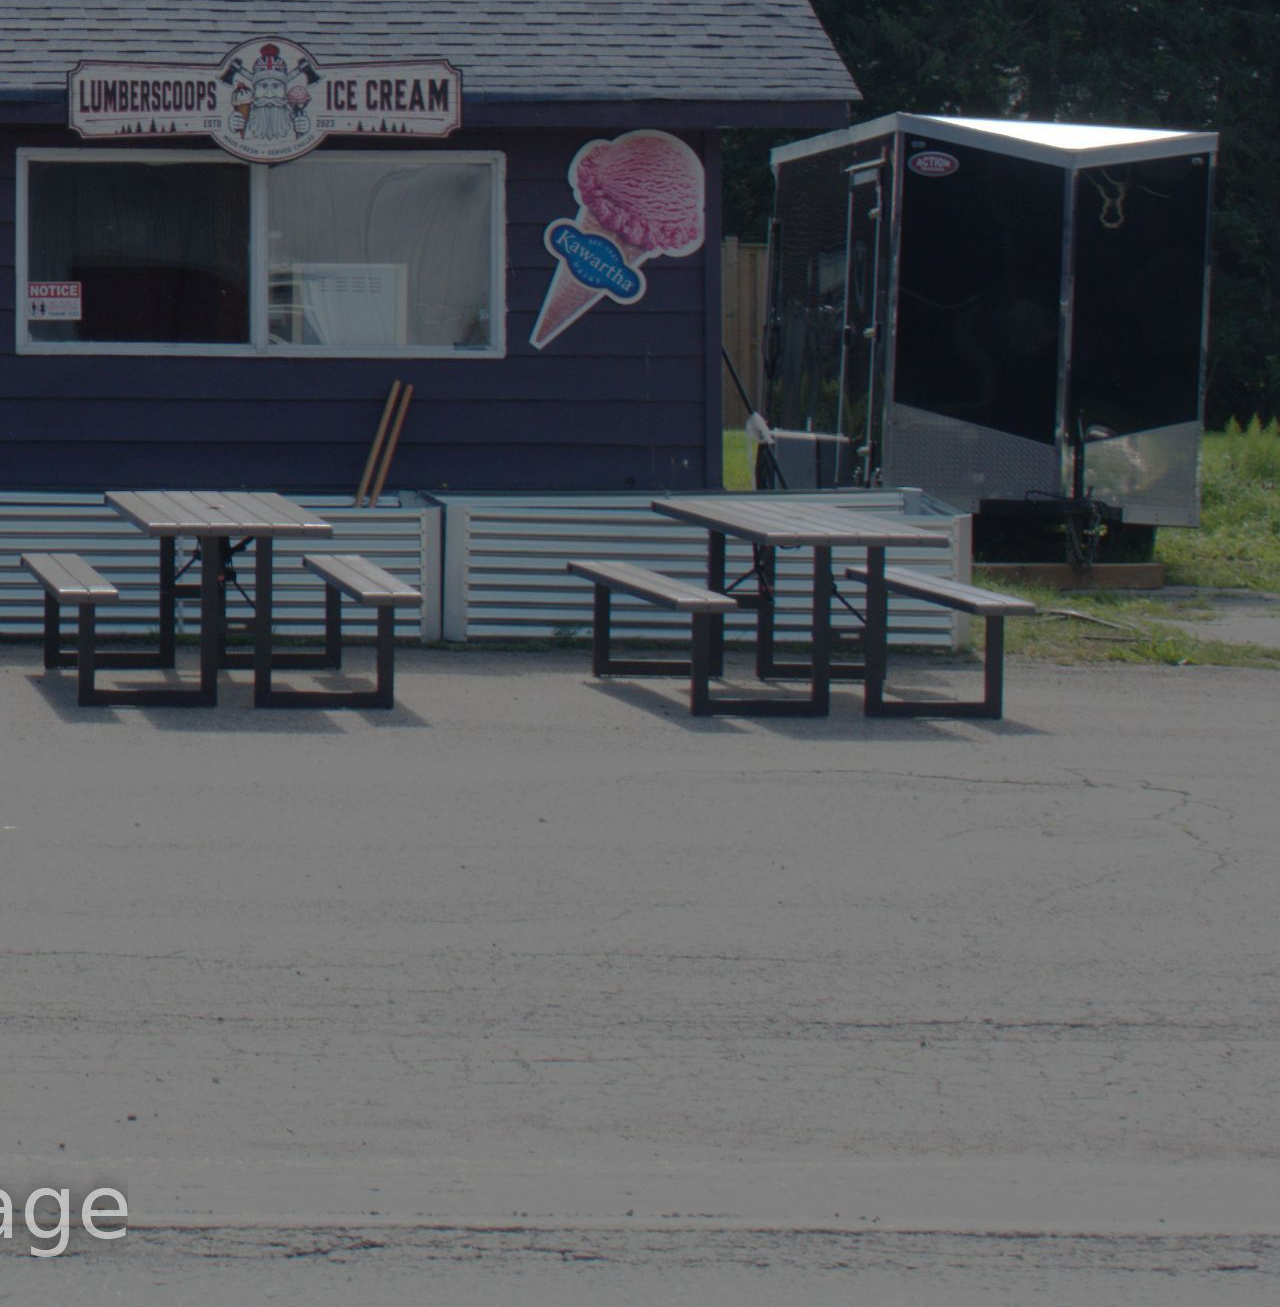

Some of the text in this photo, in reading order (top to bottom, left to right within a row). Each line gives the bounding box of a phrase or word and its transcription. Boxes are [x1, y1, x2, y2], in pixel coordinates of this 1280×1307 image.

[79, 79, 217, 113] LUMBERSCOOPS
[326, 79, 450, 112] ICE CREAM
[916, 156, 951, 168] ACTION
[556, 229, 636, 292] Kawartha
[30, 285, 78, 296] NOTICE
